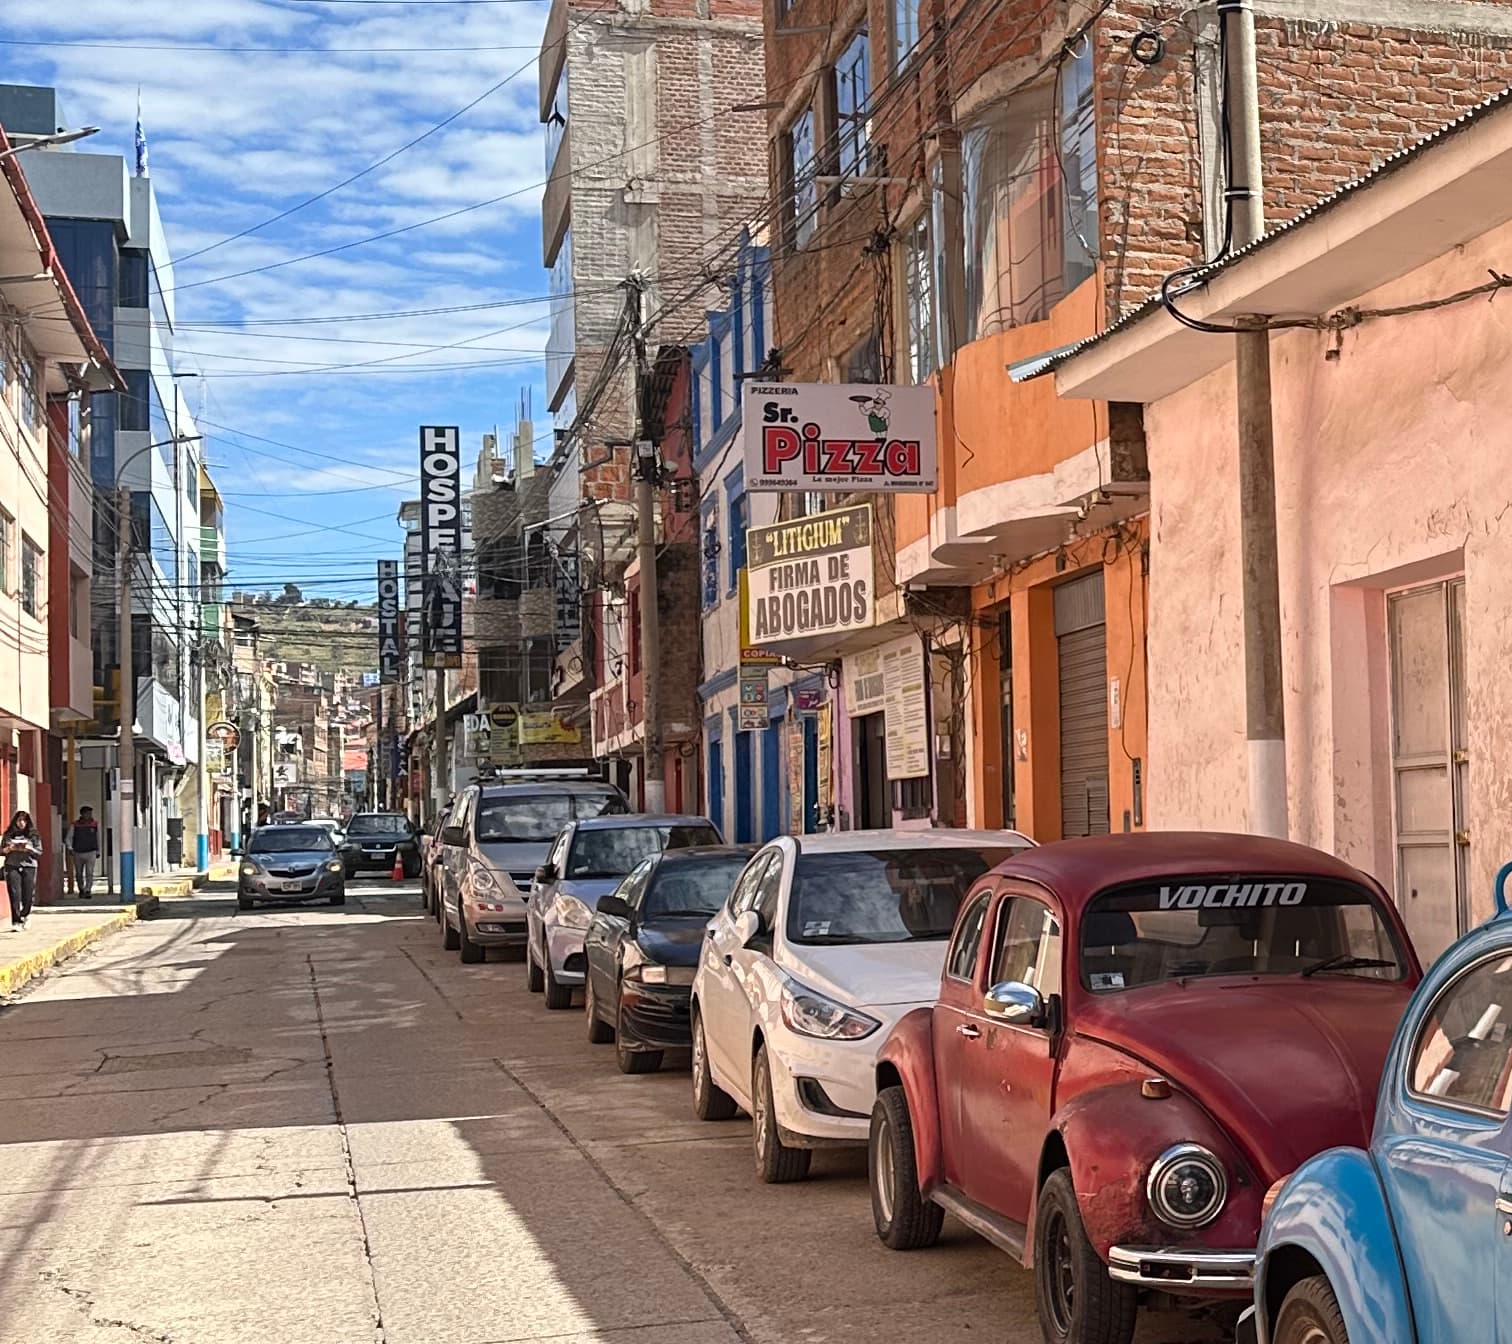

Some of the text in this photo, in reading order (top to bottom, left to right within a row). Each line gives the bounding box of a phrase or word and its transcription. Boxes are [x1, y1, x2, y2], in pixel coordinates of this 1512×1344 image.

[751, 387, 799, 396] PIZZERIA
[763, 401, 799, 423] Sr.
[762, 422, 921, 476] Pizza
[769, 553, 850, 593] FIRMA DE
[379, 560, 399, 676] HOSTAL
[755, 579, 868, 640] ABOGADOS
[1158, 882, 1307, 909] VOCHITO
